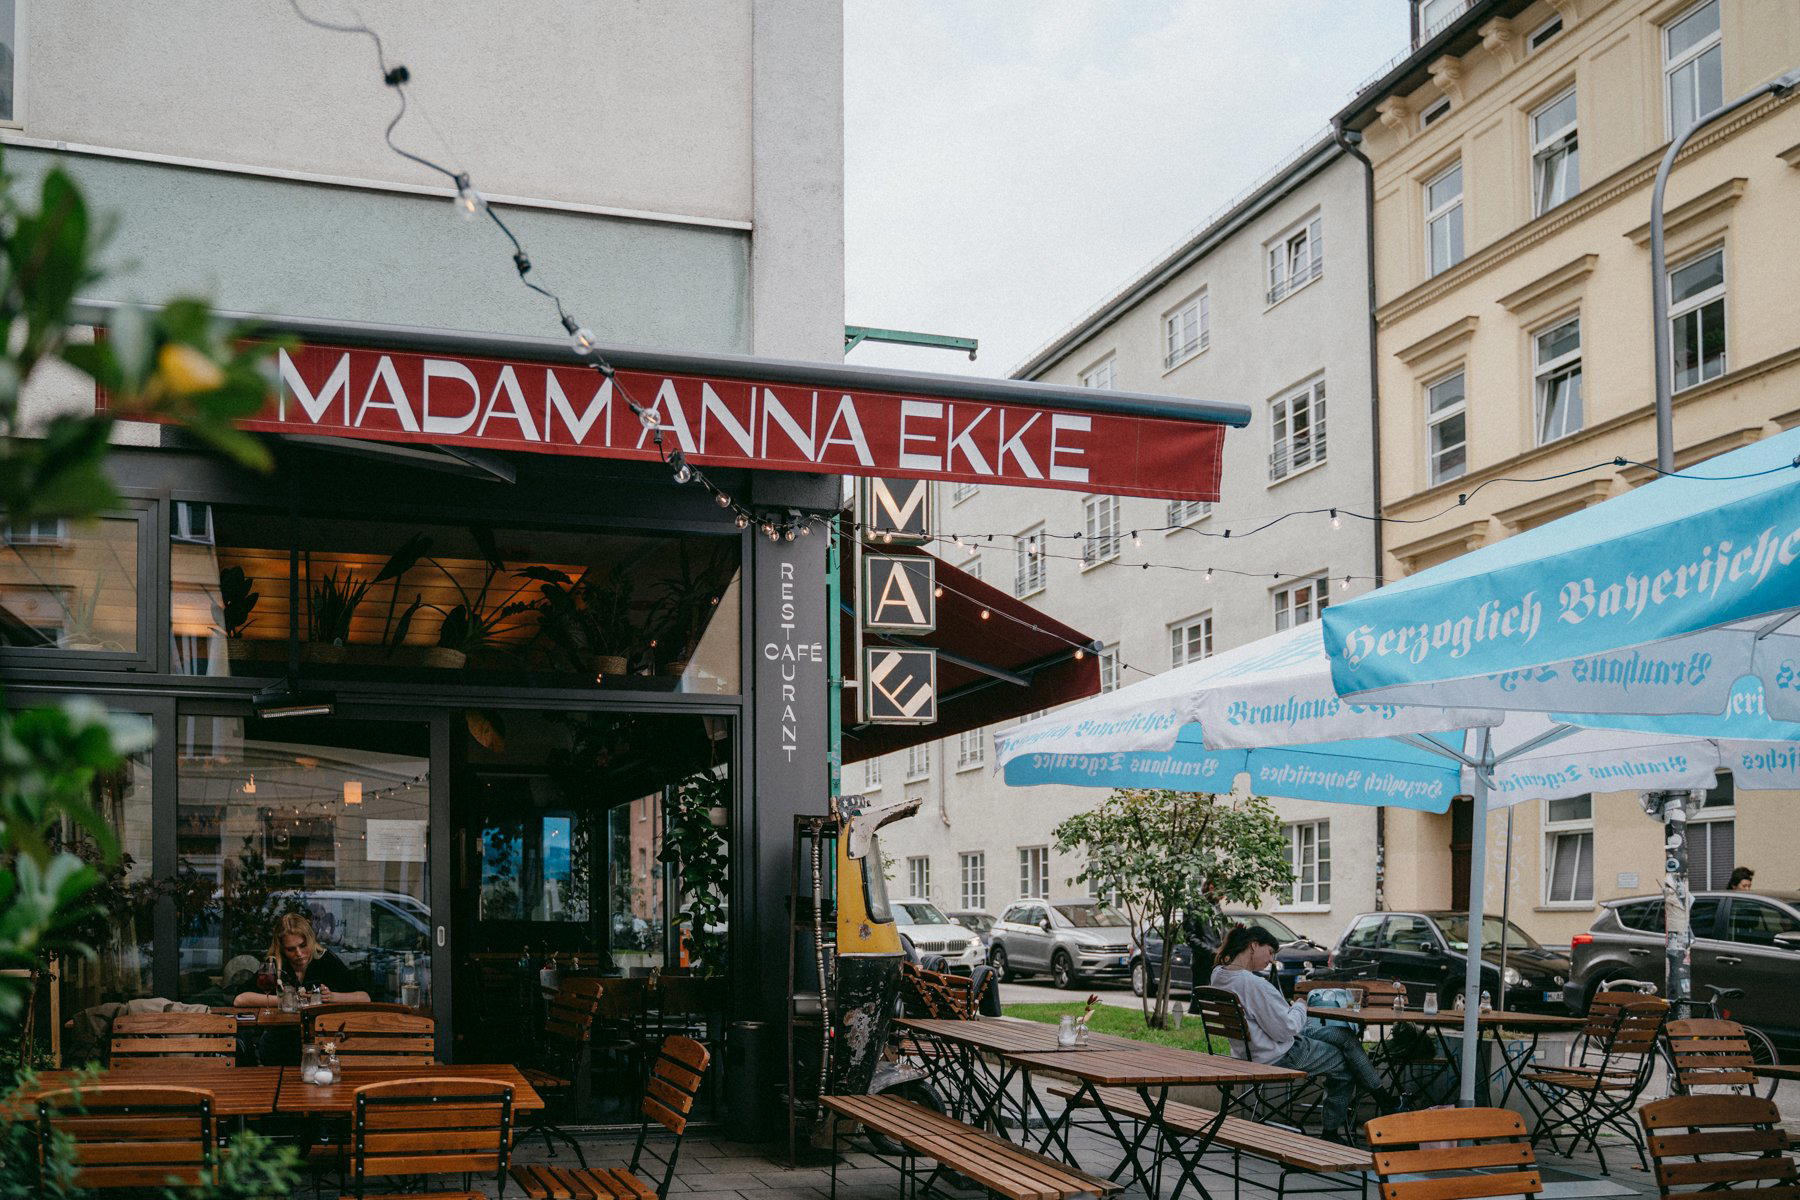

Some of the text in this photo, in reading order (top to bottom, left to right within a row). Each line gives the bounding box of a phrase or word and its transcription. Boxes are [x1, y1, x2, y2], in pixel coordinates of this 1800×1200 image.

[279, 346, 1092, 483] MADAM ANNA EKKE
[764, 642, 823, 662] CAFÉ
[780, 562, 797, 763] RESTAURANT
[1343, 589, 1541, 672] Herzoglich
[1226, 694, 1340, 729] Brauhaus
